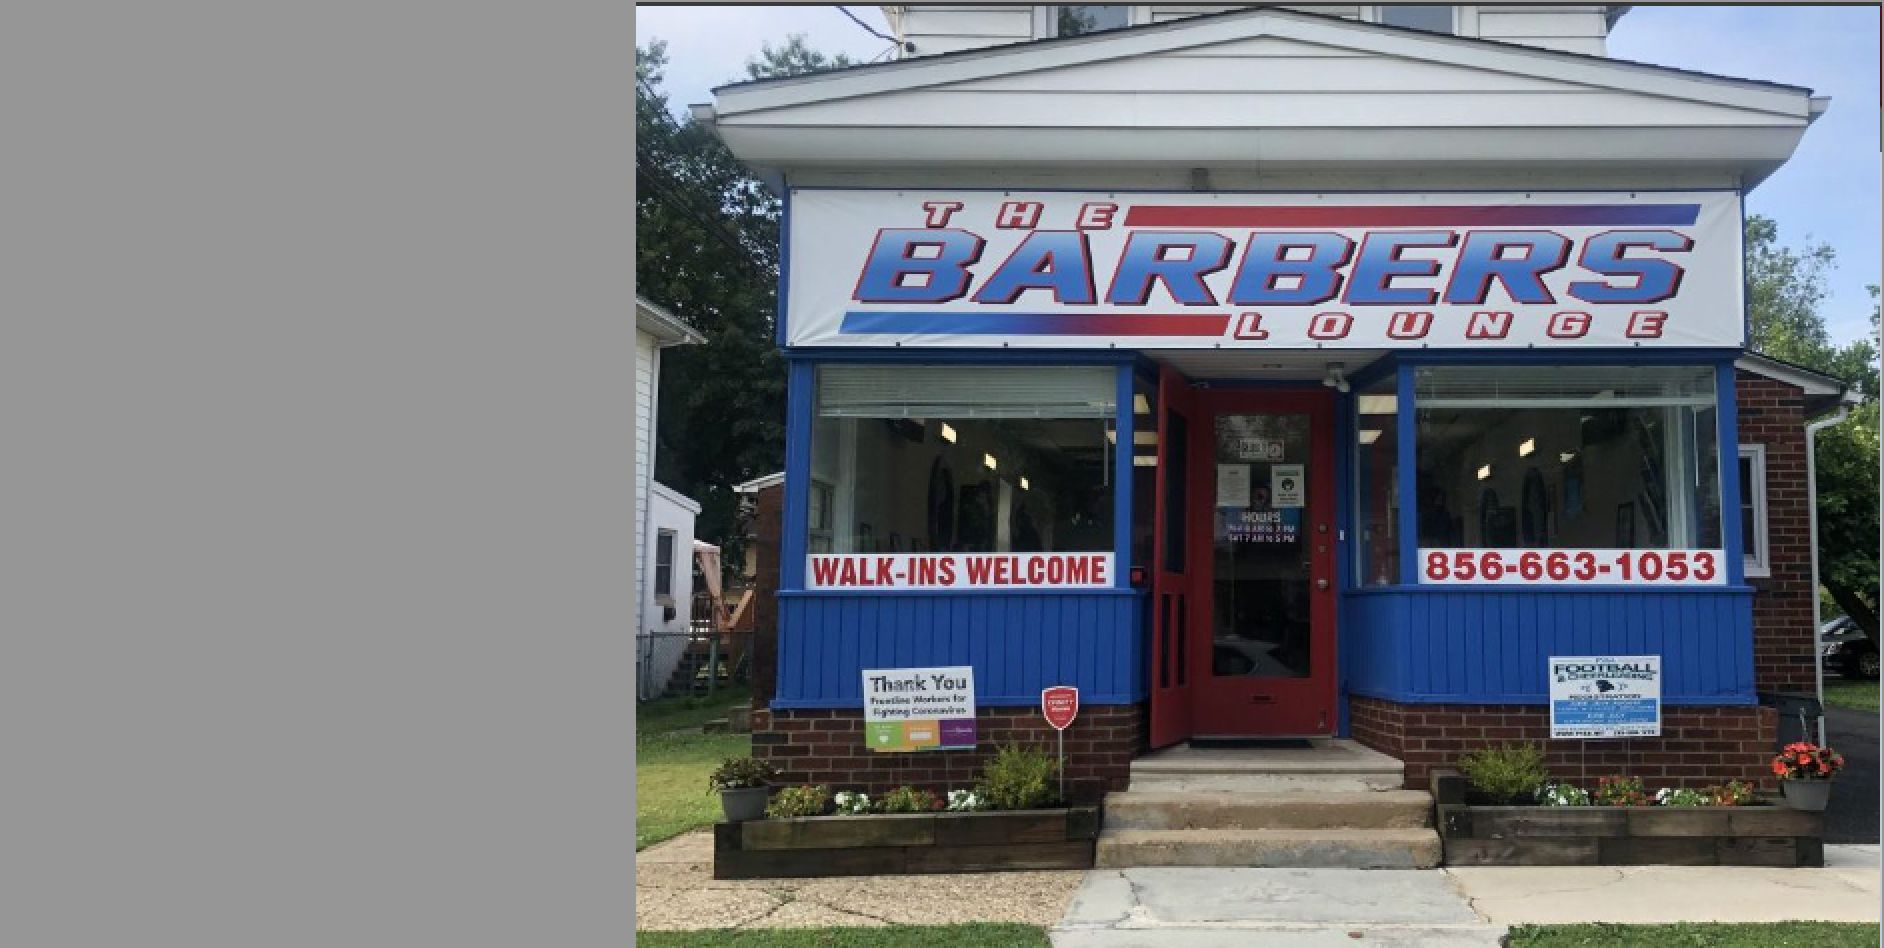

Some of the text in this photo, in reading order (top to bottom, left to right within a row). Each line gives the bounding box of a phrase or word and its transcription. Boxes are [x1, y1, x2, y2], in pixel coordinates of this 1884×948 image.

[922, 202, 1118, 230] THE
[852, 228, 1696, 306] BARBERS
[1233, 311, 1669, 341] LOUNGE
[1241, 511, 1281, 523] HOURS
[1283, 534, 1295, 542] PM
[811, 555, 1107, 587] WALK-INS WELCOME
[1425, 551, 1716, 581] 856-663-1053
[1554, 664, 1656, 675] FOOTBALL
[869, 674, 967, 692] Thank You
[870, 694, 967, 705] Frontline Workers for
[873, 706, 967, 718] Fighting Coronavirus
